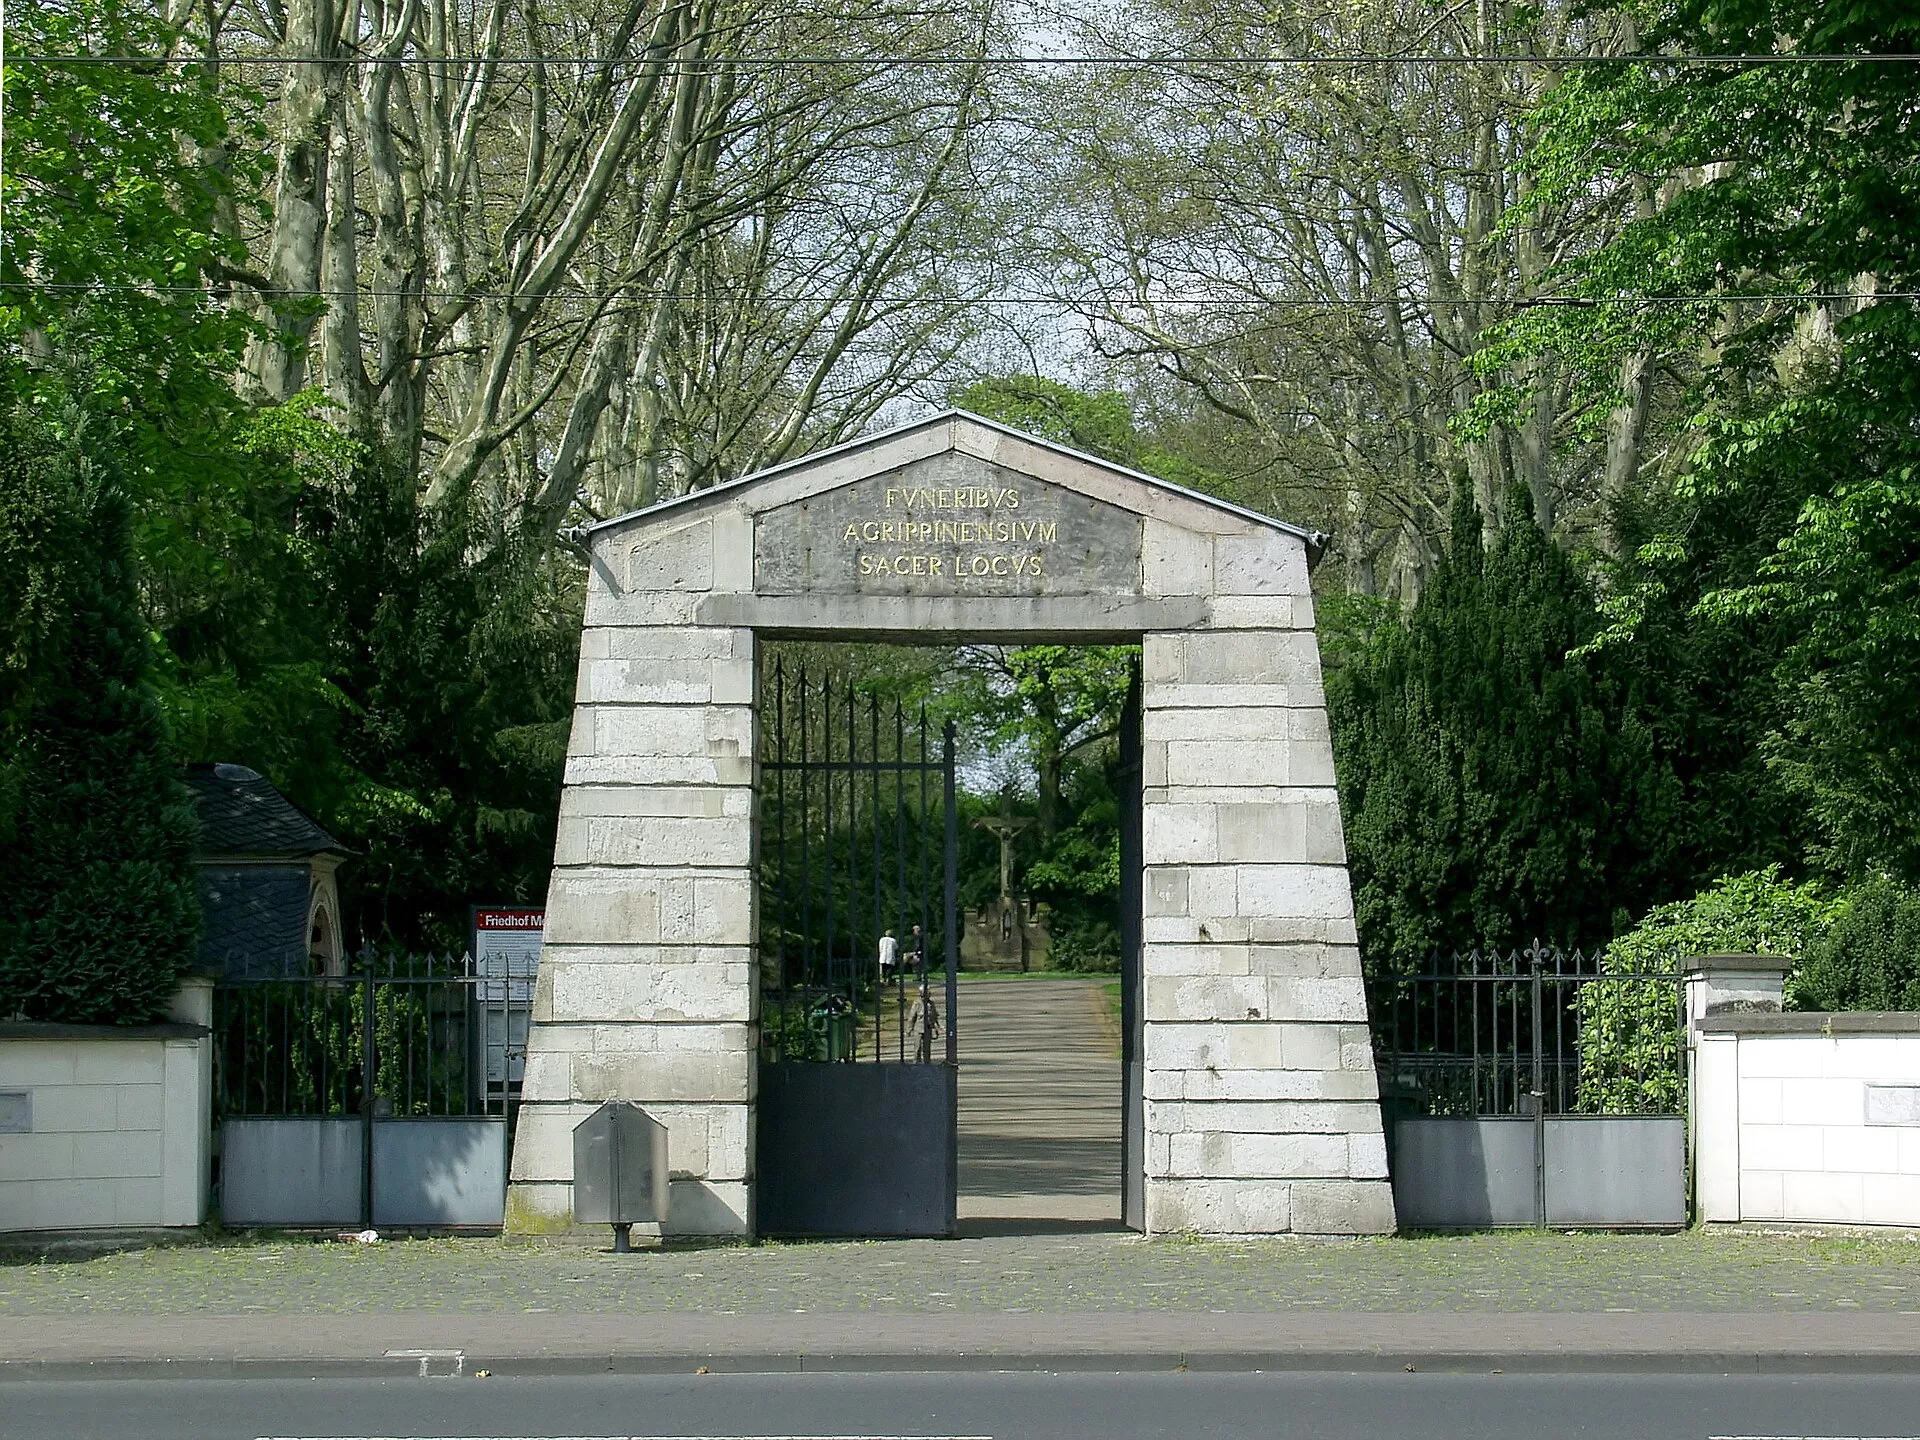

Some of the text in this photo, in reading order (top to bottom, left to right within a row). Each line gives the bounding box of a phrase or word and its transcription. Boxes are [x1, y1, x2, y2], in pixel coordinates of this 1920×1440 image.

[885, 487, 1020, 509] FVNERIBVS
[843, 521, 1058, 543] AGRIPPINENSIVM
[859, 555, 1043, 576] SACER LOCVS
[485, 914, 529, 927] Friedhof
